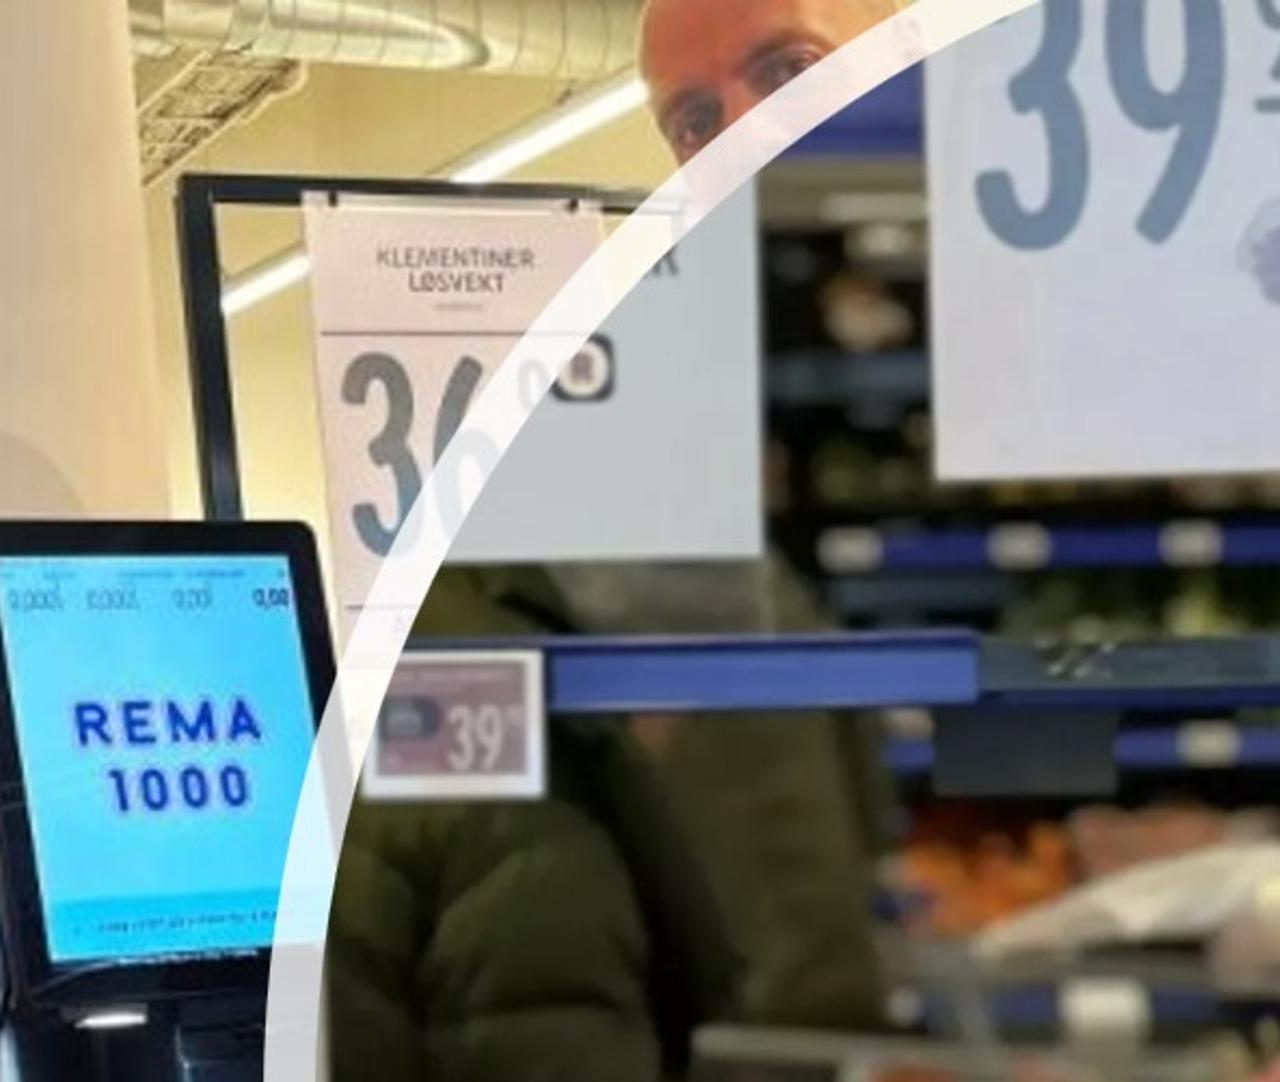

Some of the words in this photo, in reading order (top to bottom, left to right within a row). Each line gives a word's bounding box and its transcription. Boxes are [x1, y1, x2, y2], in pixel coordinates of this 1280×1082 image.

[975, 0, 1227, 251] 39
[377, 247, 535, 269] KLEMENTINER
[408, 273, 505, 293] LØSVEKT
[73, 699, 263, 747] REMA
[447, 703, 505, 771] 39
[108, 765, 252, 812] 1000
